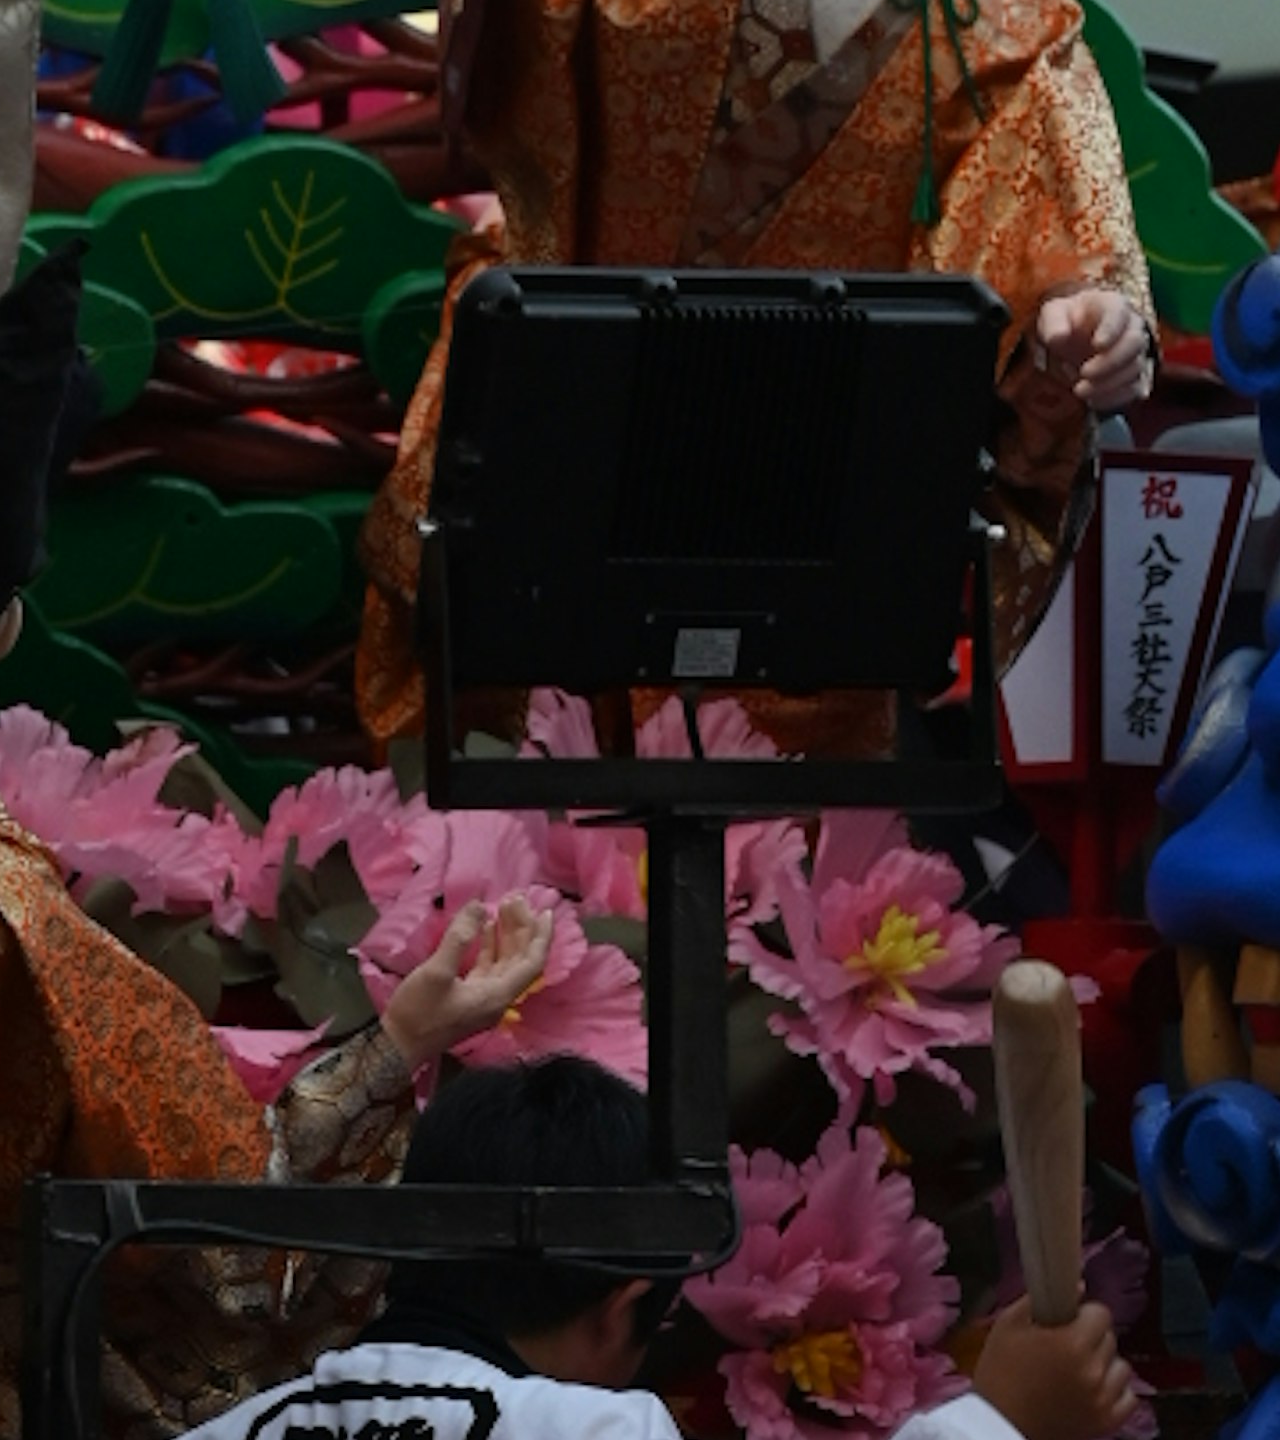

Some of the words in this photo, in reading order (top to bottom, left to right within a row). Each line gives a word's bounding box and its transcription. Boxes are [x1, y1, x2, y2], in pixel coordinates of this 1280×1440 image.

[1140, 475, 1183, 519] 祝
[1123, 533, 1182, 740] 八戸三社大祭
